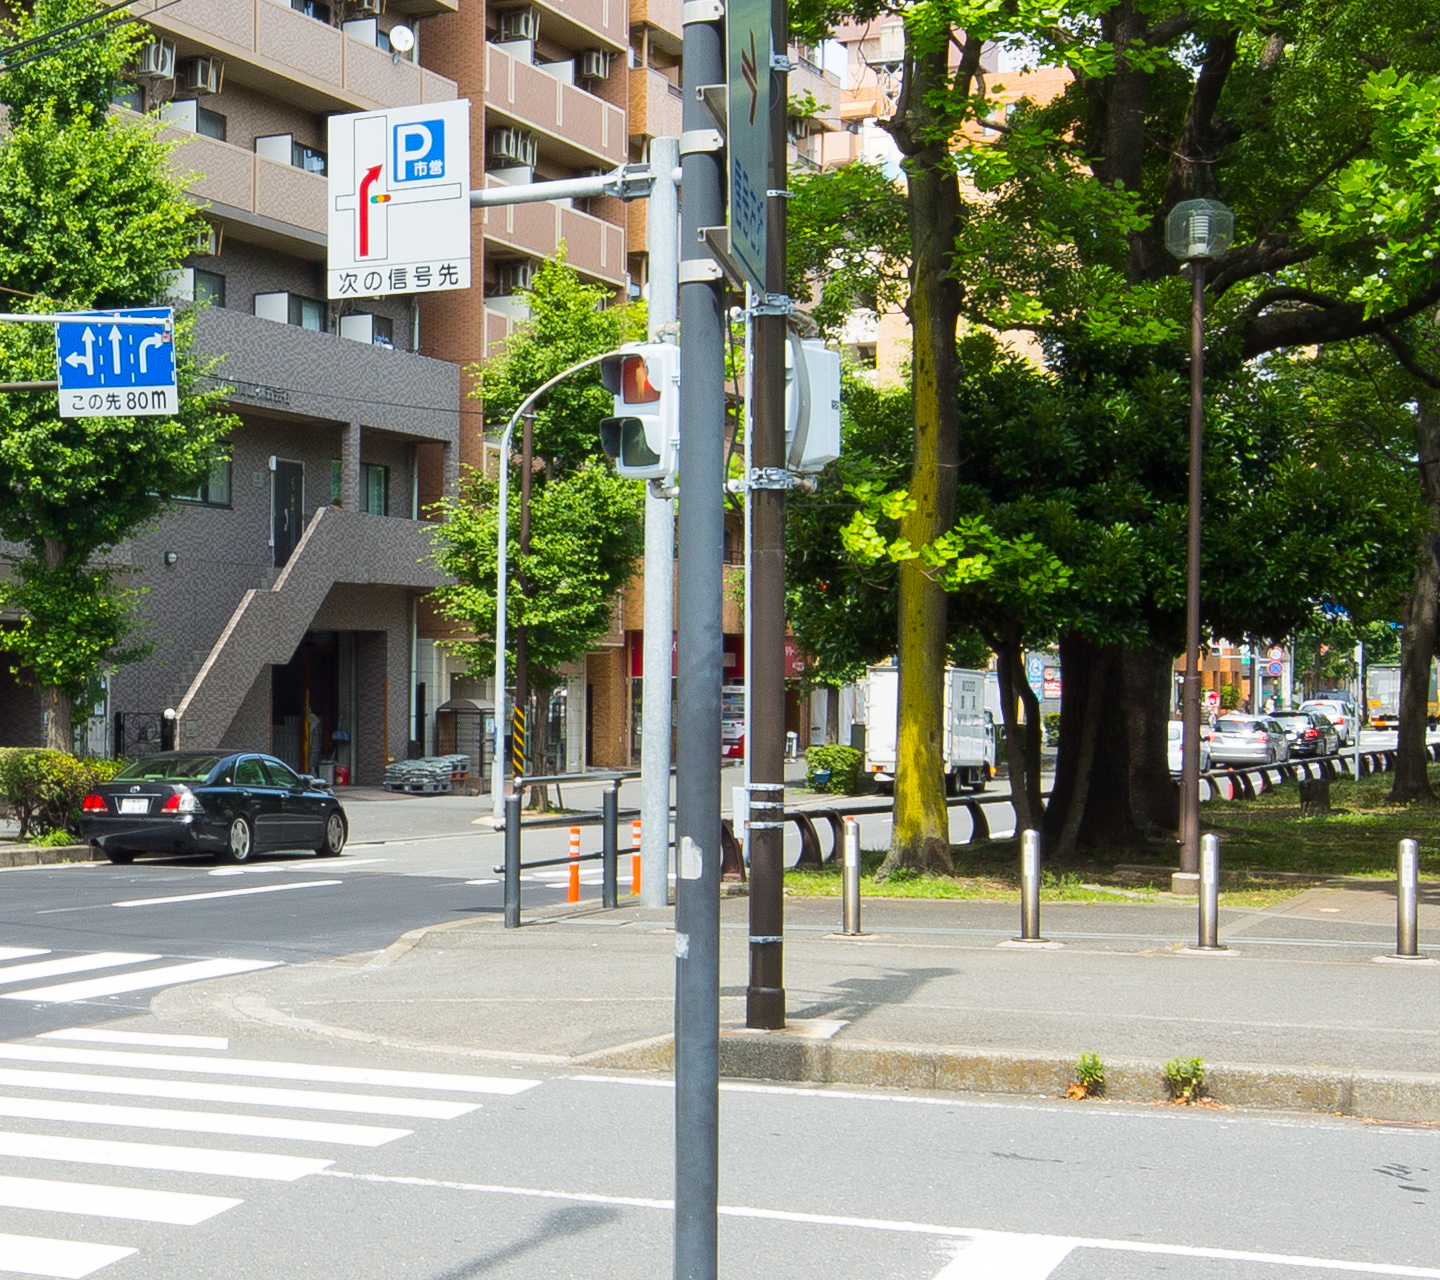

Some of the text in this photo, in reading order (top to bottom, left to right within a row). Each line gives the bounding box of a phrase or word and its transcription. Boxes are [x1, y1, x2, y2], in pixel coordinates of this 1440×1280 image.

[396, 124, 433, 180] P
[413, 159, 444, 177] 市営
[339, 263, 459, 294] 次の信号先
